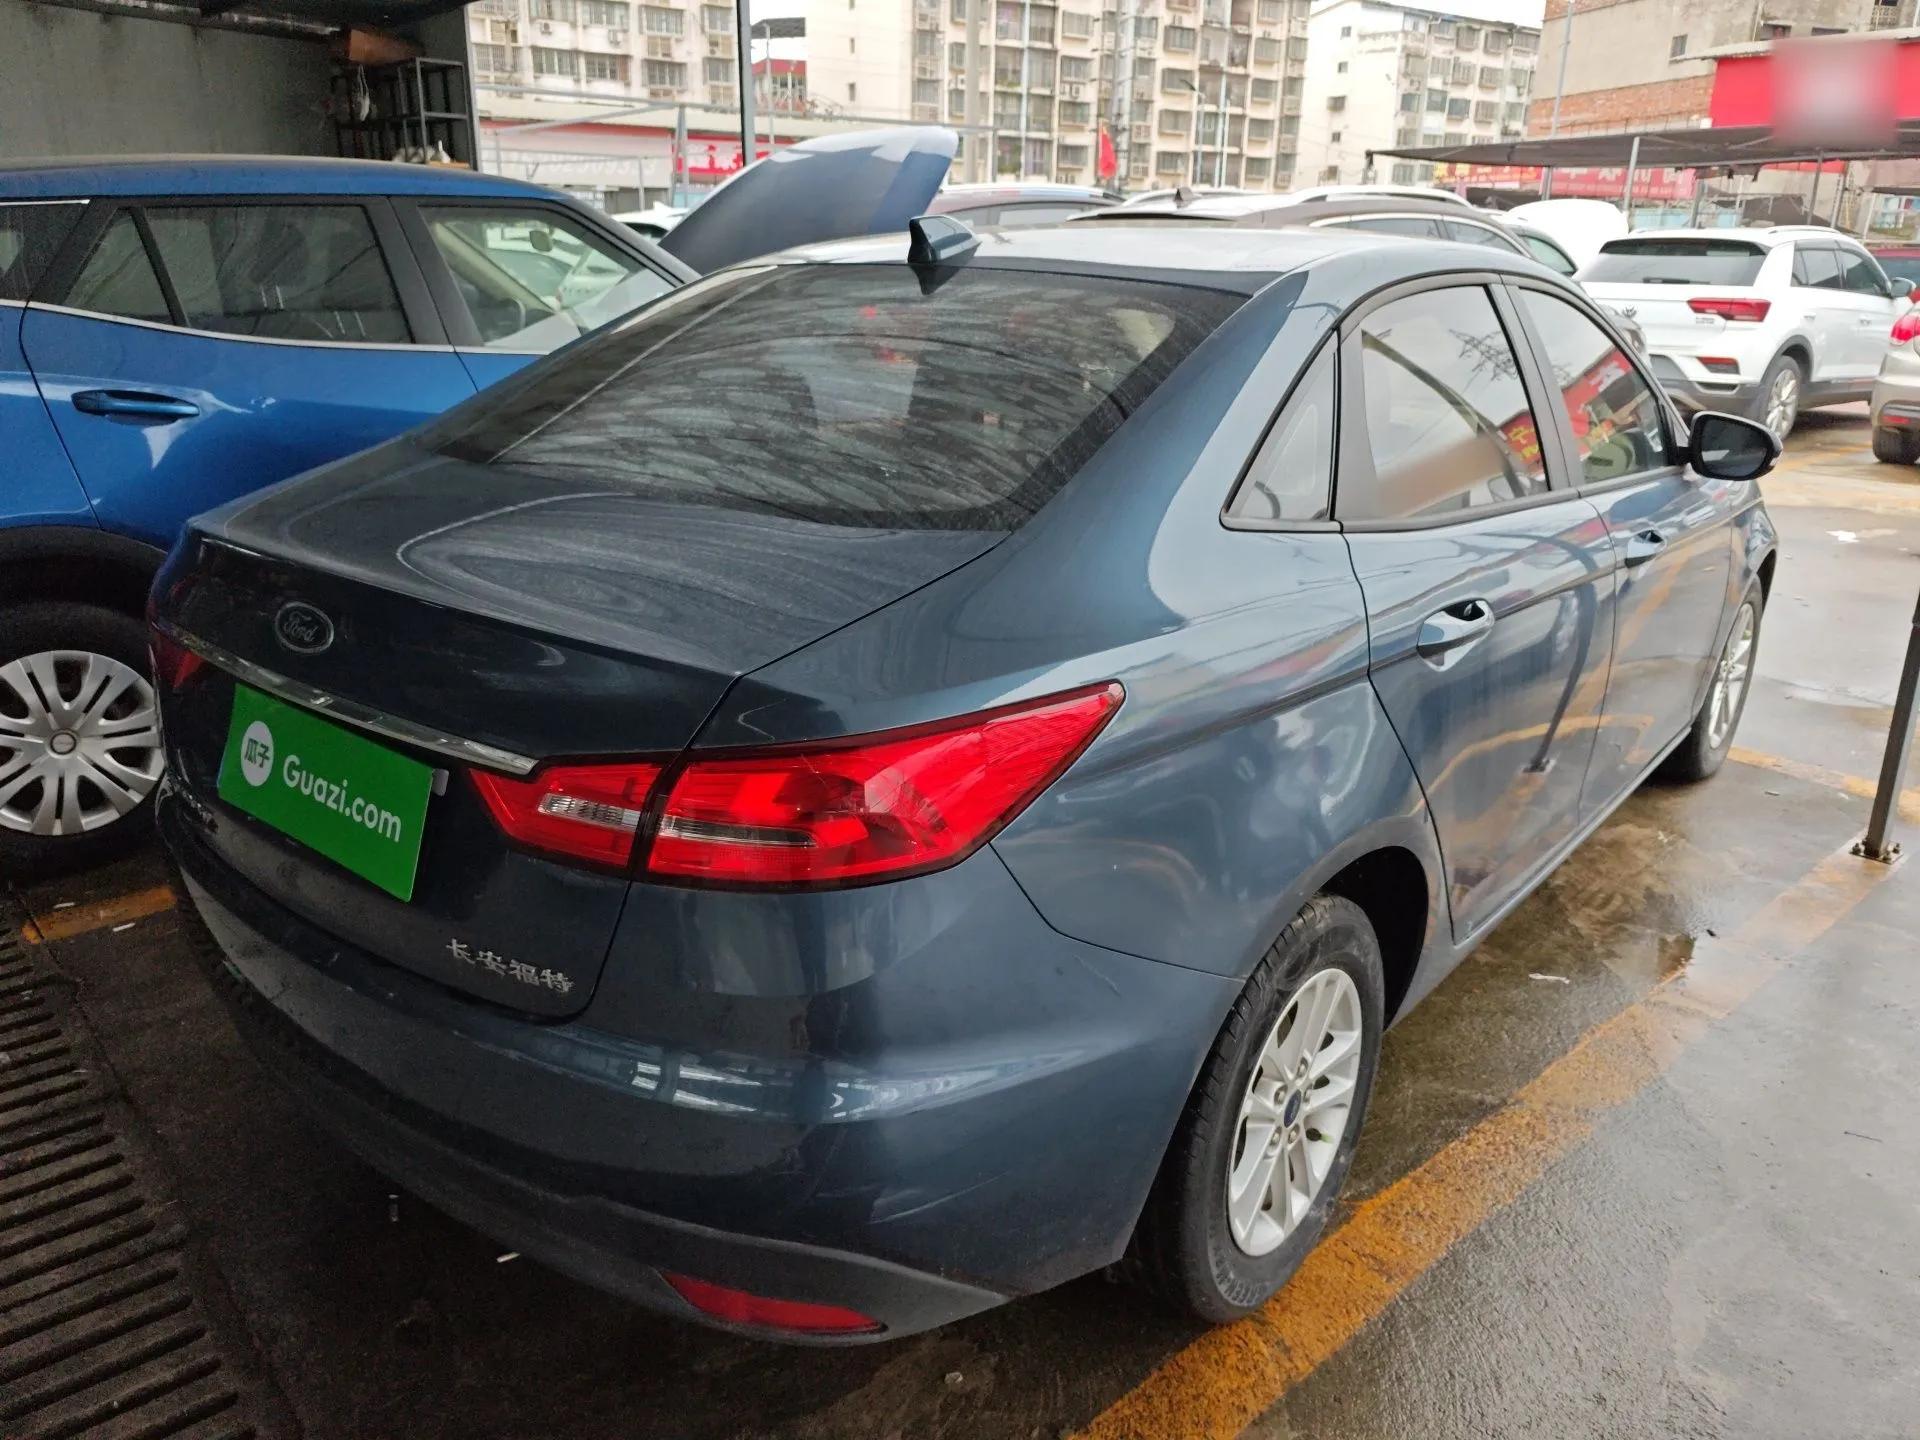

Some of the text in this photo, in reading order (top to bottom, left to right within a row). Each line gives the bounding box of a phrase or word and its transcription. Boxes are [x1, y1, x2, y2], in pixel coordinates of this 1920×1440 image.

[244, 737, 271, 769] 瓜子
[283, 754, 402, 842] Guazi.com
[446, 938, 575, 993] 长安福特
